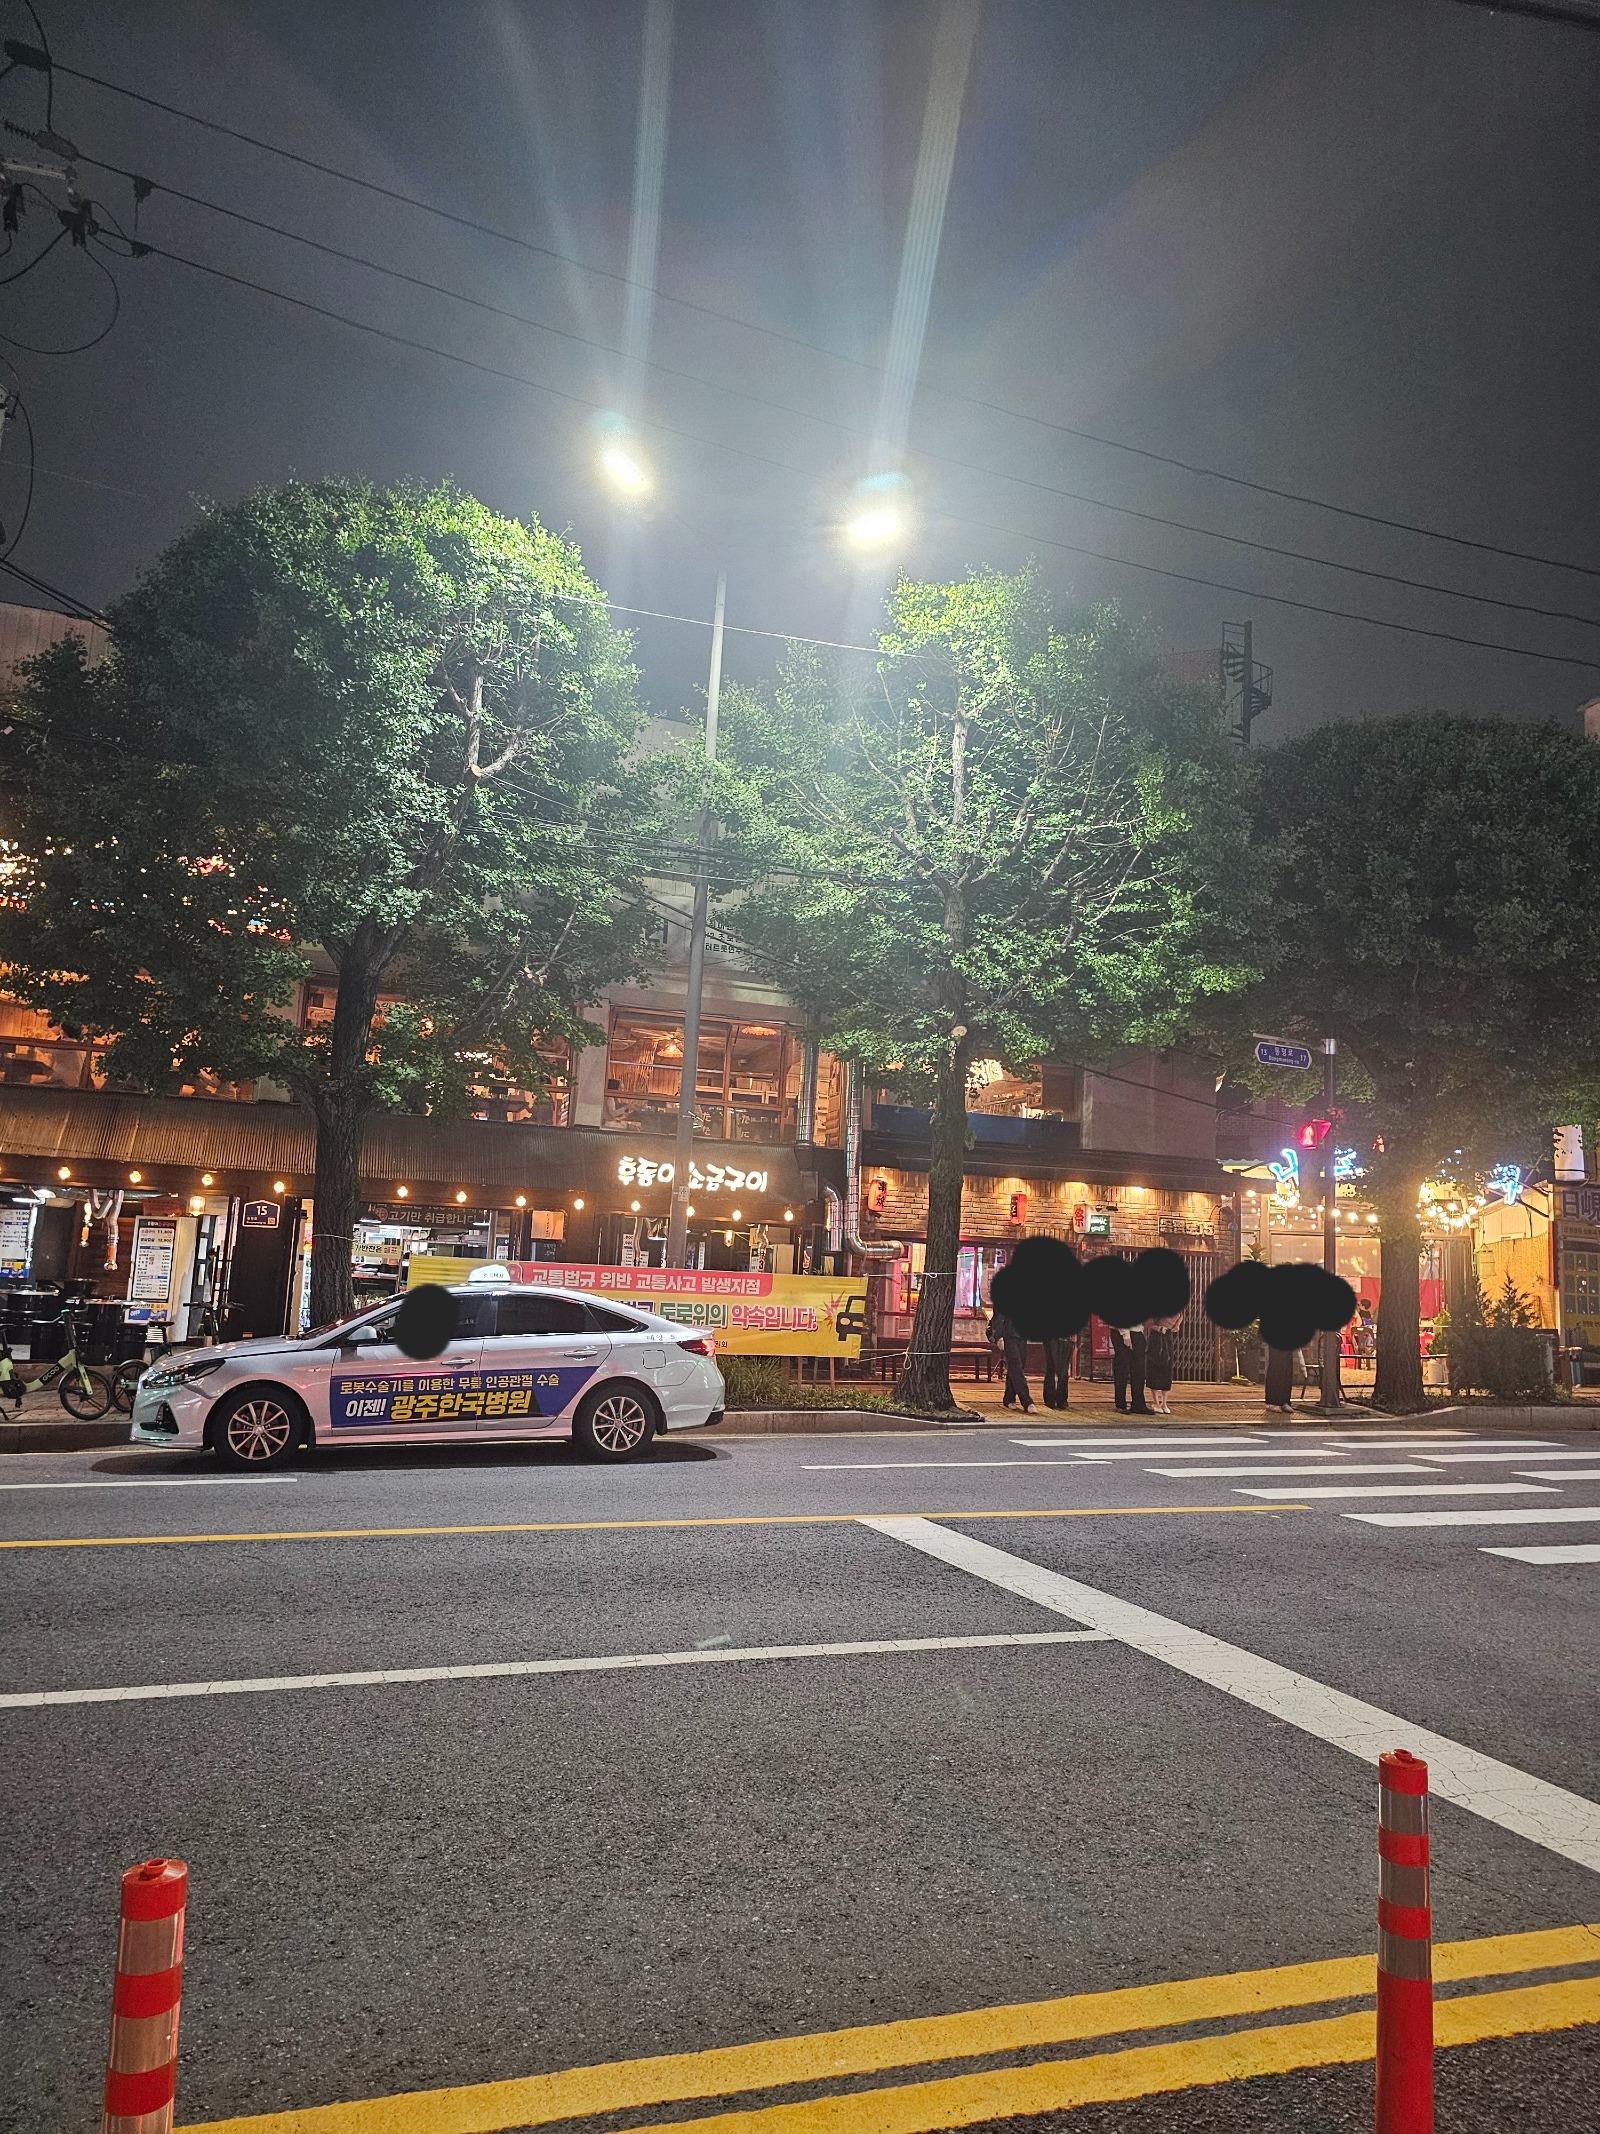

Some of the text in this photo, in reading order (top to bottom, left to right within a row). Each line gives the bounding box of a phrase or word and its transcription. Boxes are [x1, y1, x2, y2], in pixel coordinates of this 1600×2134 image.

[688, 1161, 768, 1193] 소금구이
[257, 1206, 268, 1216] 15
[388, 1210, 421, 1222] 고기만
[532, 1268, 761, 1295] 교통법규 위반 교통사고 발생지점
[659, 1302, 728, 1328] 도로위의
[340, 1374, 560, 1394] 로봇수술기를 이용한 무릎 인공관절 수술
[345, 1390, 532, 1420] 이젠! 광주한국병원
